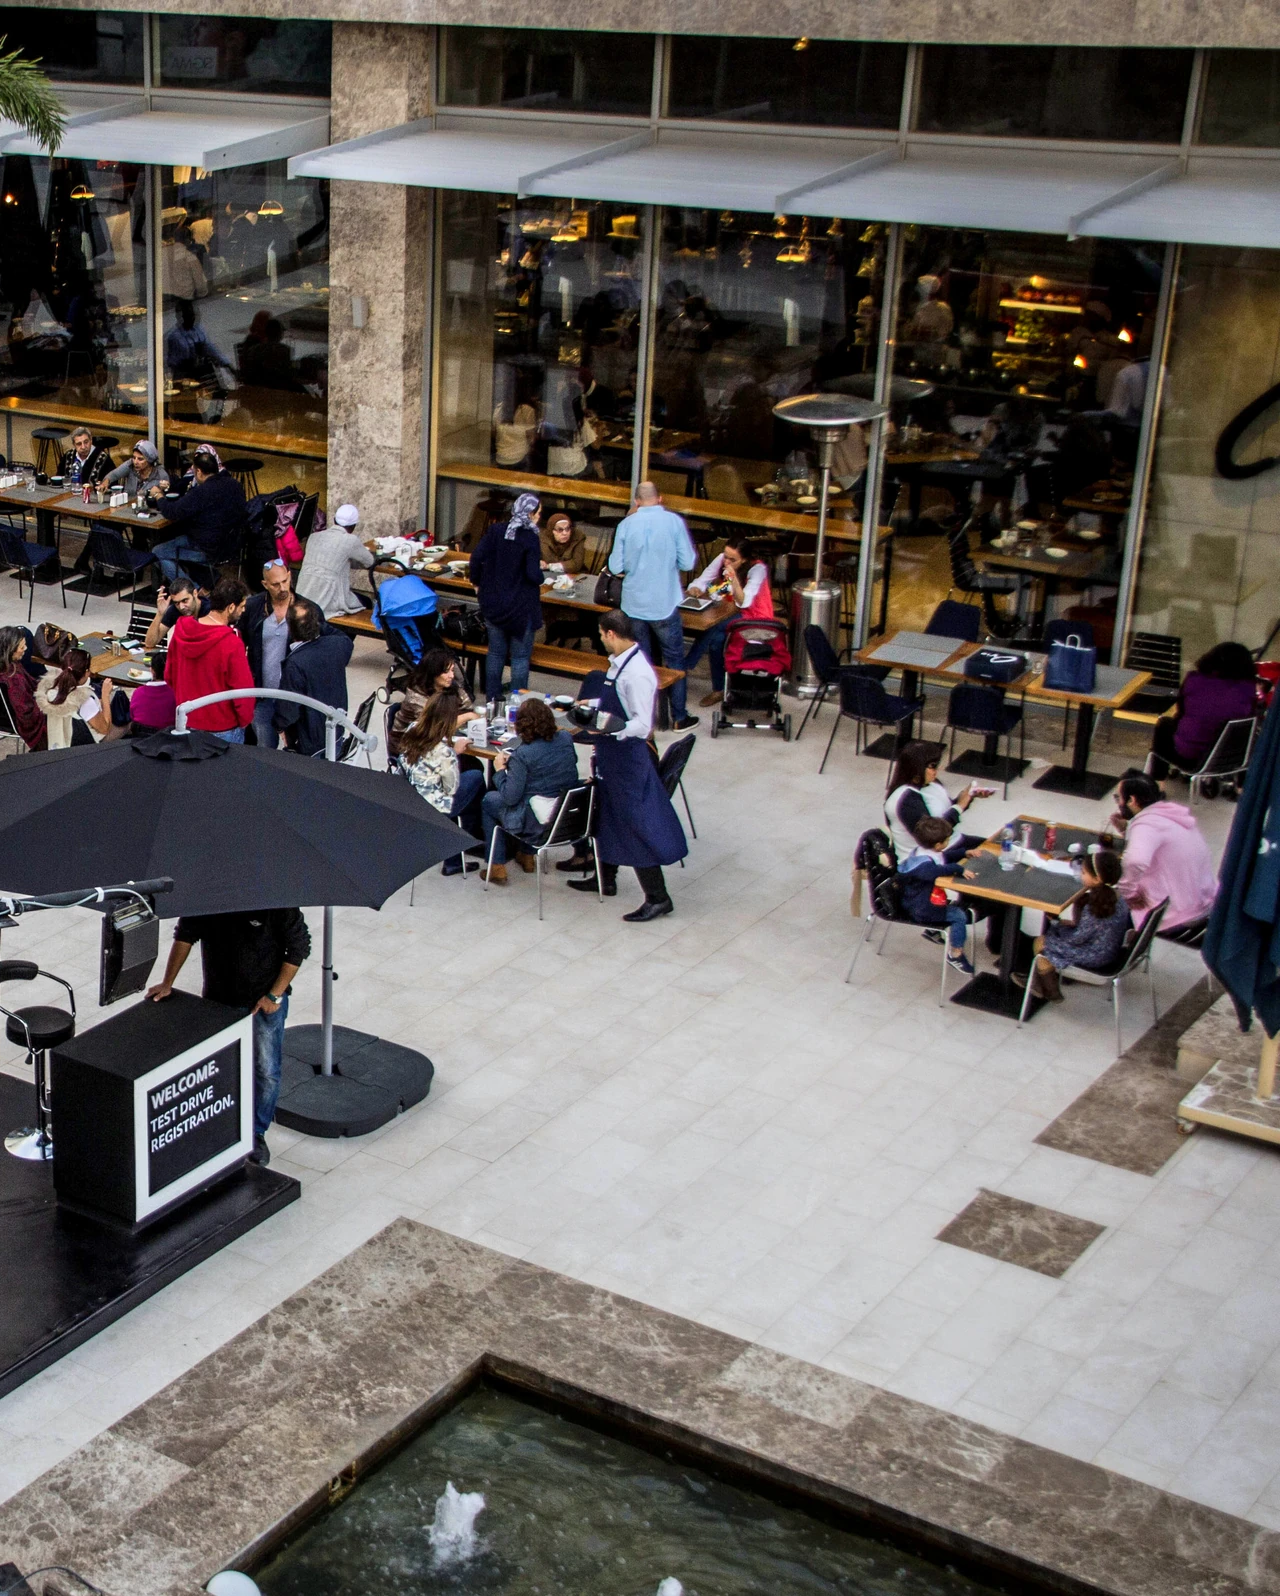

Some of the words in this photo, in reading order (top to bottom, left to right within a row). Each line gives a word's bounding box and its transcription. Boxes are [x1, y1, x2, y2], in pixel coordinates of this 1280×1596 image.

[150, 1106, 178, 1133] TEST
[179, 1085, 214, 1118] DRIVE
[151, 1059, 220, 1110] WELCOME.
[150, 1093, 235, 1153] REGISTRATION.
